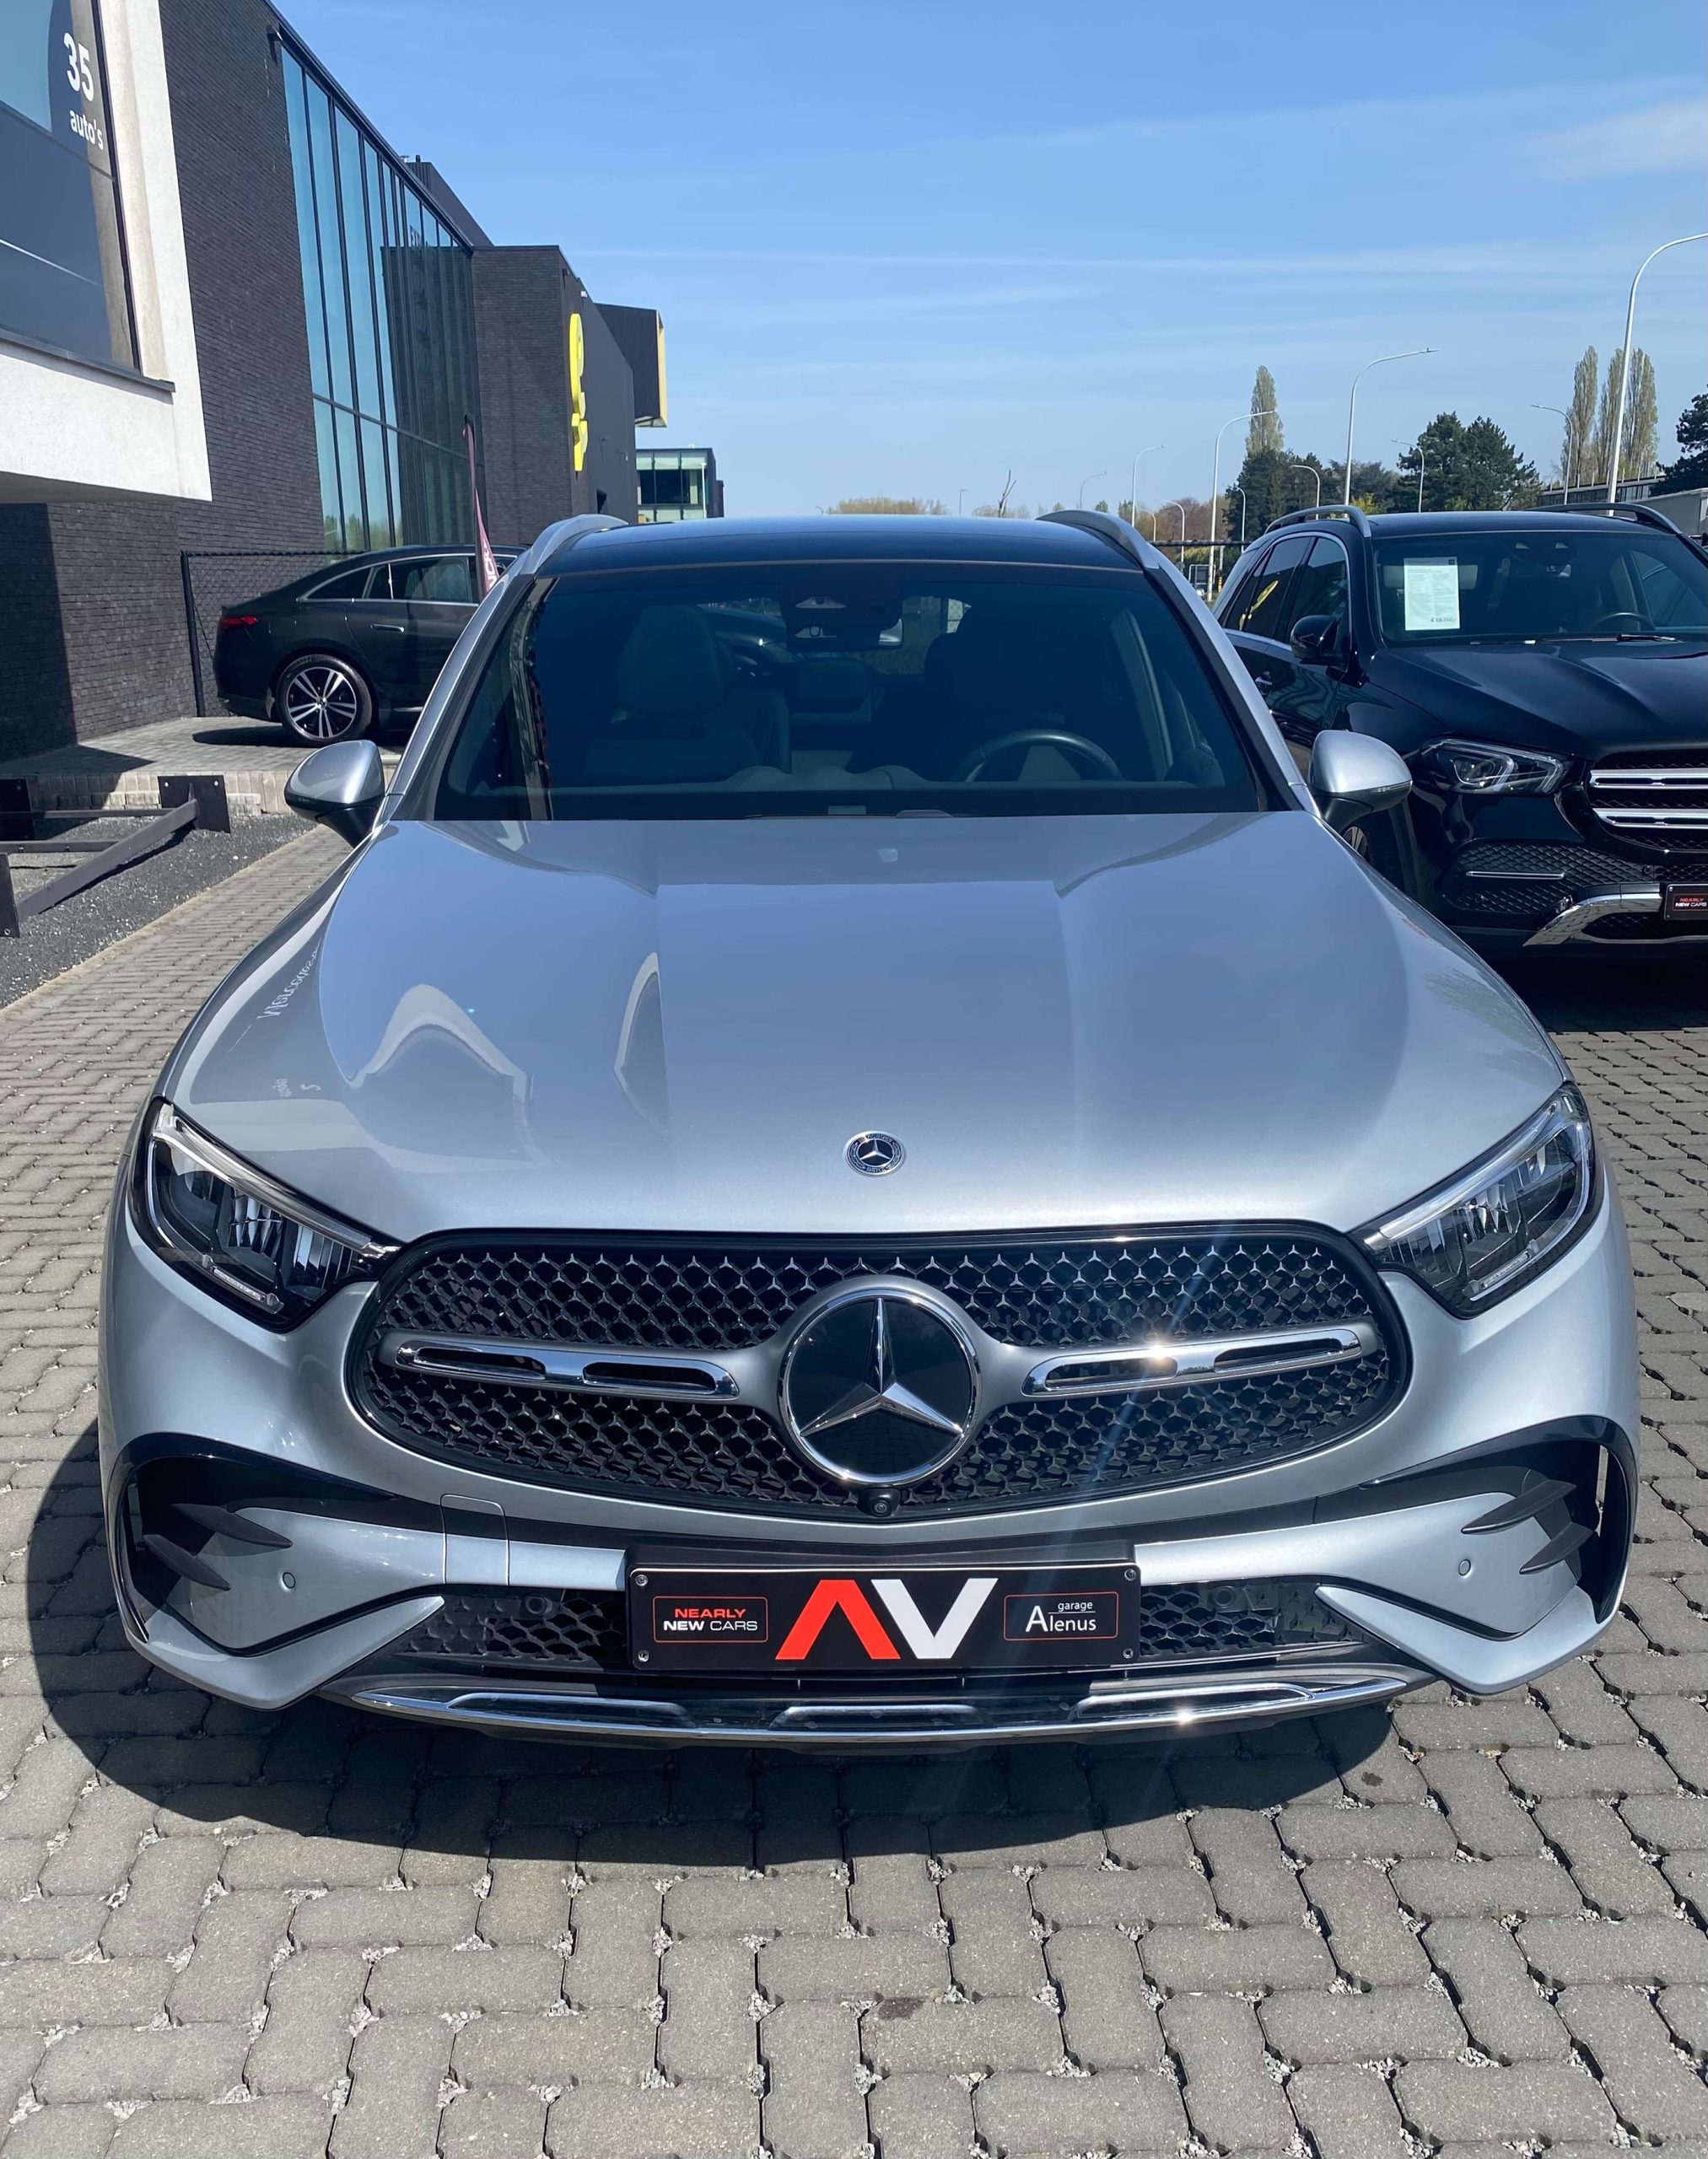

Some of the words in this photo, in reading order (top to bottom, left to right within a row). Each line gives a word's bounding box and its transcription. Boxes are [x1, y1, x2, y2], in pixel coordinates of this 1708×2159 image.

[63, 32, 94, 102] 35
[69, 110, 104, 150] auto's
[675, 1608, 746, 1618] NEARLY
[1058, 1602, 1093, 1613] garage
[663, 1620, 705, 1631] NEW
[709, 1620, 758, 1631] CARS
[1025, 1605, 1096, 1633] Alenus
